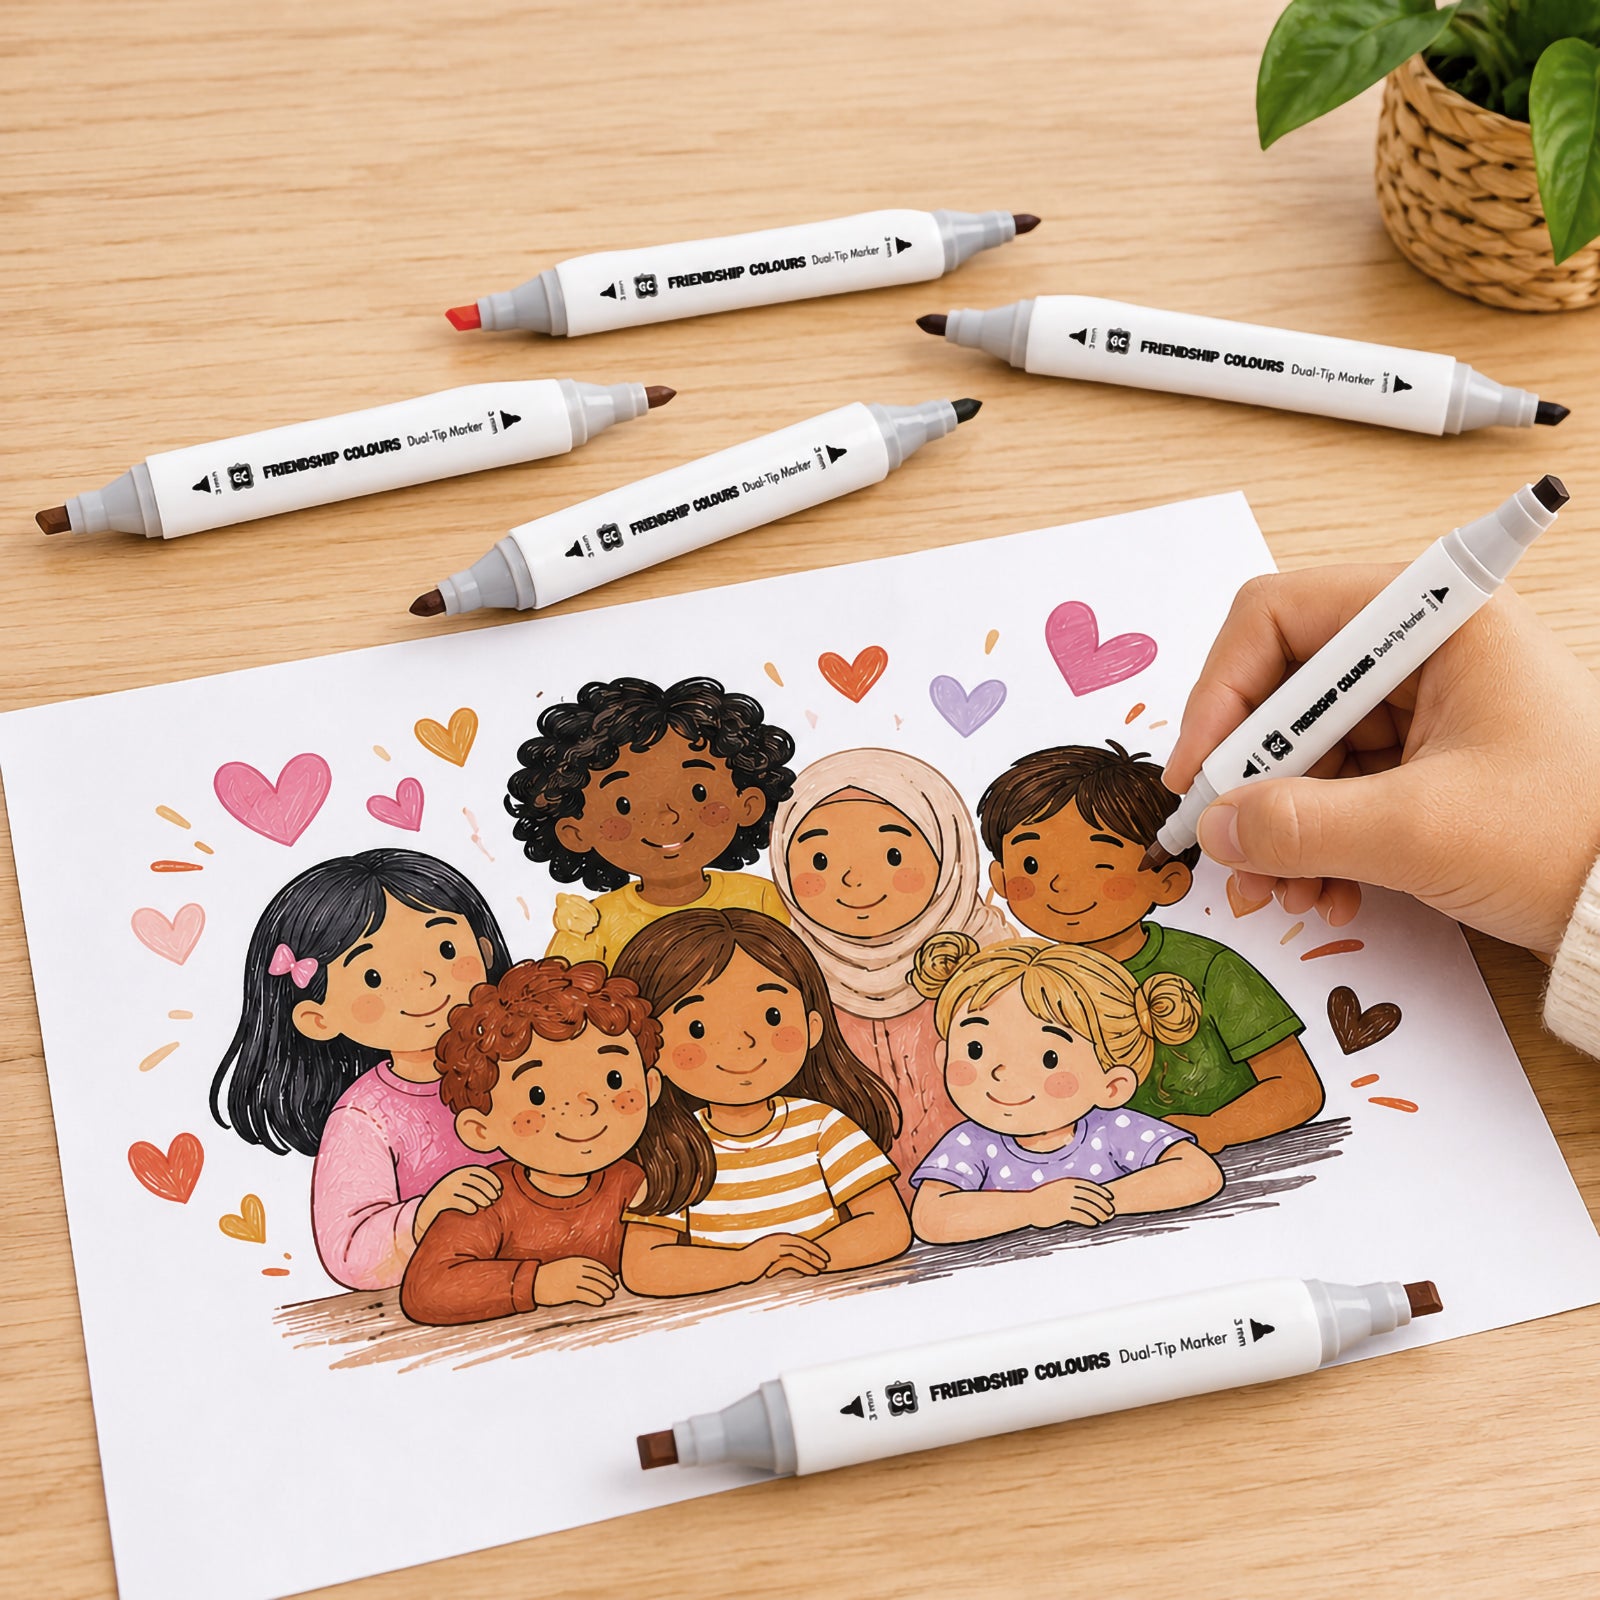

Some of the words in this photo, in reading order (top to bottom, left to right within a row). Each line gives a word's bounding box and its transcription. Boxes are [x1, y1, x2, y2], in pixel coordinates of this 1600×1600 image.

[668, 266, 745, 289] FRIENDSHIP
[749, 256, 806, 276] COLOURS
[812, 251, 848, 265] Dual-Tip
[1141, 341, 1220, 362] FRIENDSHIP
[1224, 353, 1284, 373] COLOURS
[1291, 364, 1335, 383] Dual-Tip
[1338, 372, 1374, 385] Marker
[263, 451, 339, 479] FRIENDSHIP
[343, 438, 401, 461] COLOURS
[407, 429, 447, 446] Dual-Tip
[629, 504, 690, 536] FRIENDSHIP
[693, 486, 739, 512] COLOURS
[742, 473, 780, 493] Dual-Tip
[780, 461, 810, 478] Marker
[1337, 655, 1376, 692] COLOURS
[929, 1368, 1028, 1401] FRIENDSHIP
[1035, 1352, 1110, 1380] COLOURS
[1119, 1342, 1176, 1363] Dual-Tip
[1180, 1333, 1227, 1351] Marker
